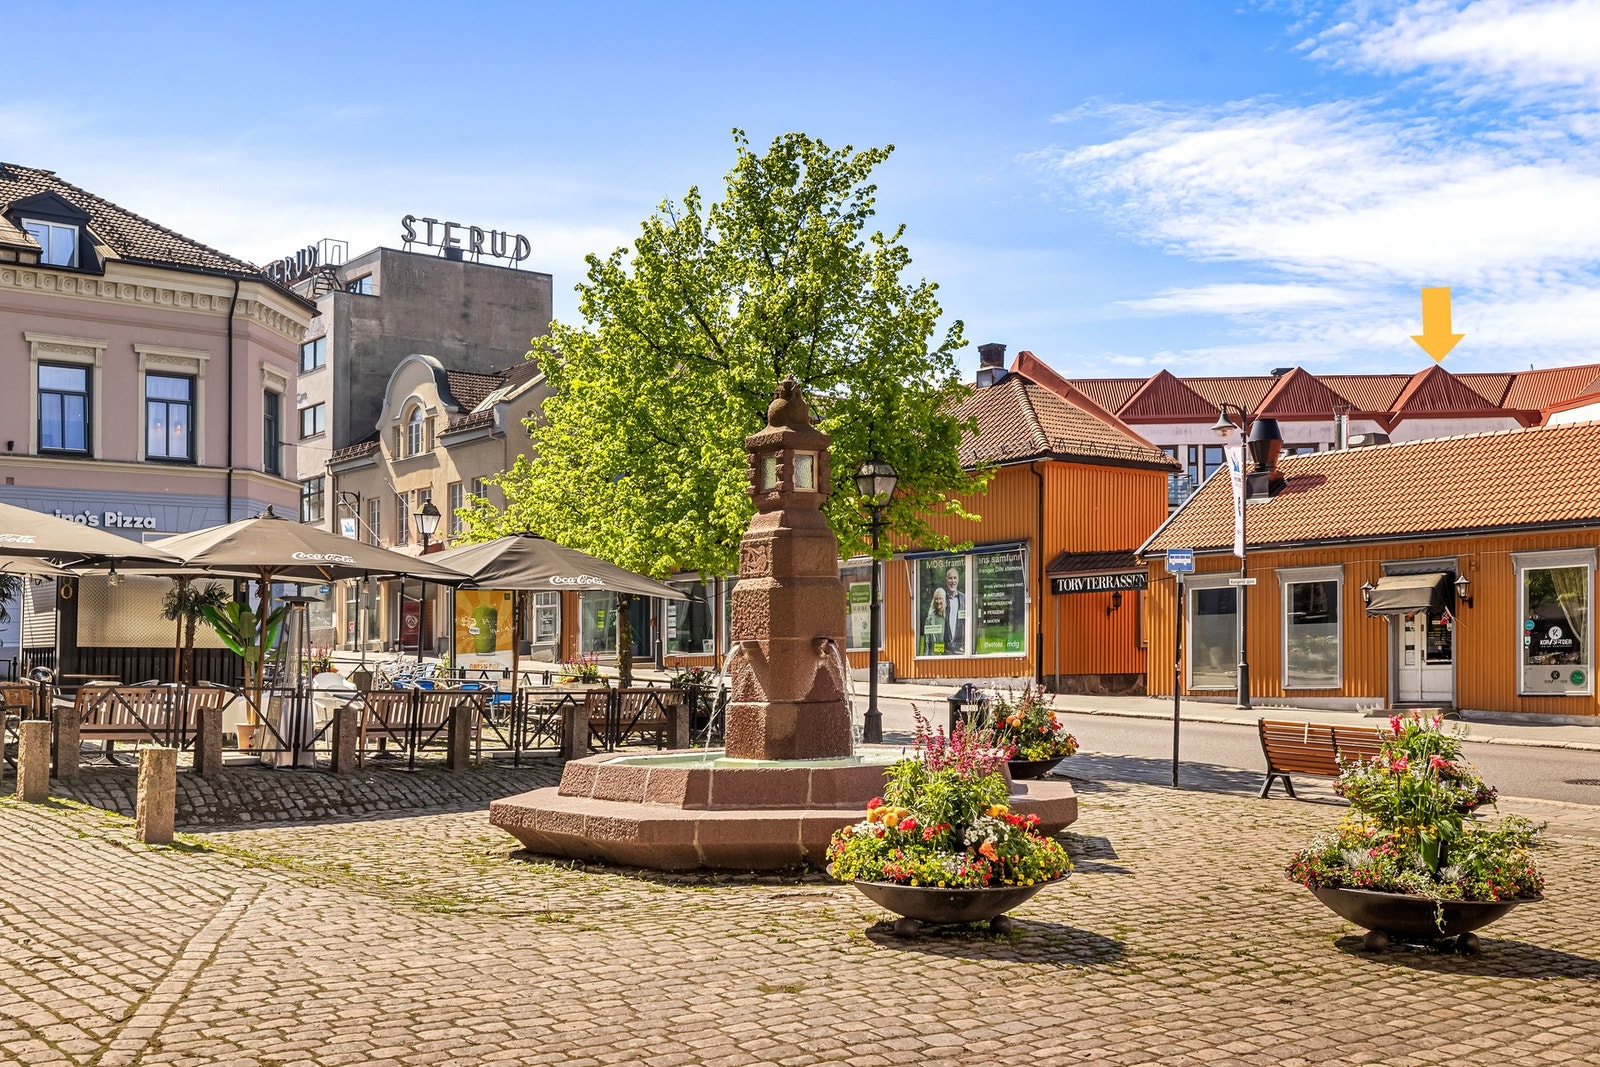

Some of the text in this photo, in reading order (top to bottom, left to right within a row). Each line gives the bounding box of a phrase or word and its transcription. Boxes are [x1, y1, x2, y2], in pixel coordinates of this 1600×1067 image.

[401, 214, 531, 261] STERUD
[264, 245, 318, 283] TERUD
[104, 511, 157, 529] Pizza
[291, 551, 357, 563] Coca-Cola
[926, 560, 944, 569] MDG
[60, 575, 73, 600] 8
[549, 574, 606, 586] Coca-Cola
[1056, 573, 1148, 592] TORVTERRASSEN
[1006, 640, 1020, 649] mdg
